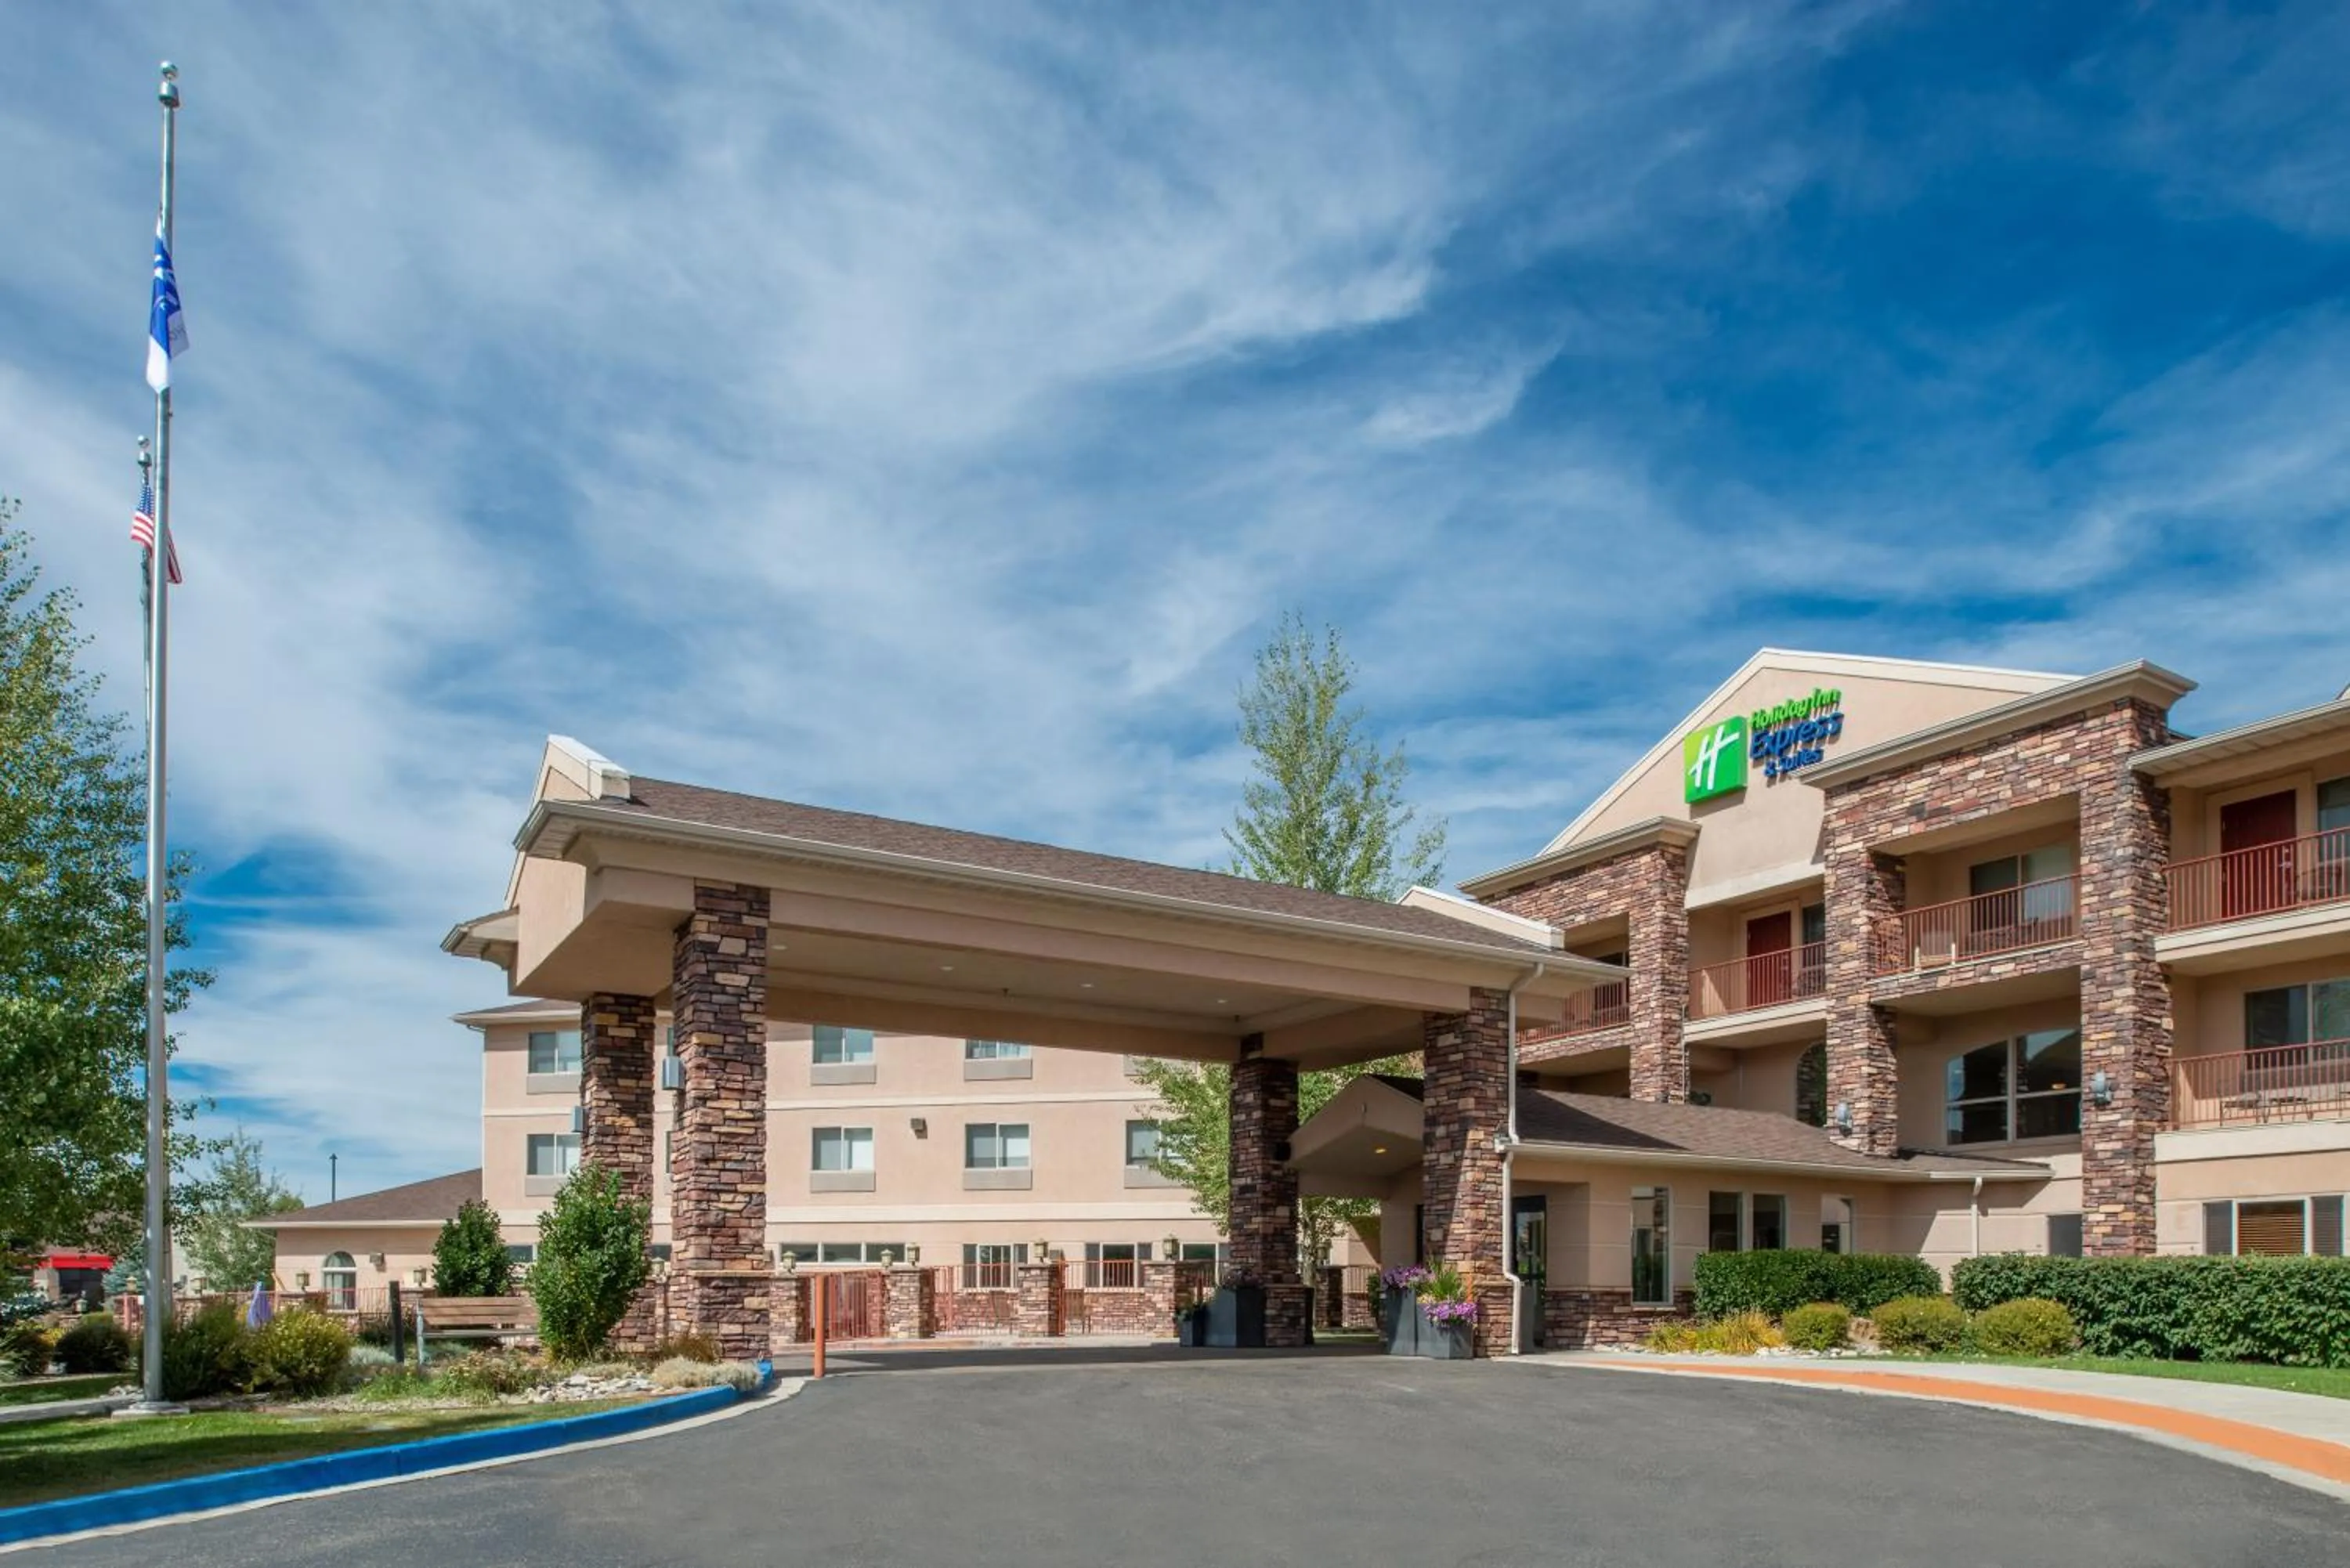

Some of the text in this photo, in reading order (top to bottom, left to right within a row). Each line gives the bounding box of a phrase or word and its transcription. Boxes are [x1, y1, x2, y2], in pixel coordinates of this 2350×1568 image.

[1752, 688, 1841, 730] Holiday Inn
[1750, 711, 1844, 760] Express
[1764, 748, 1824, 777] & Suites
